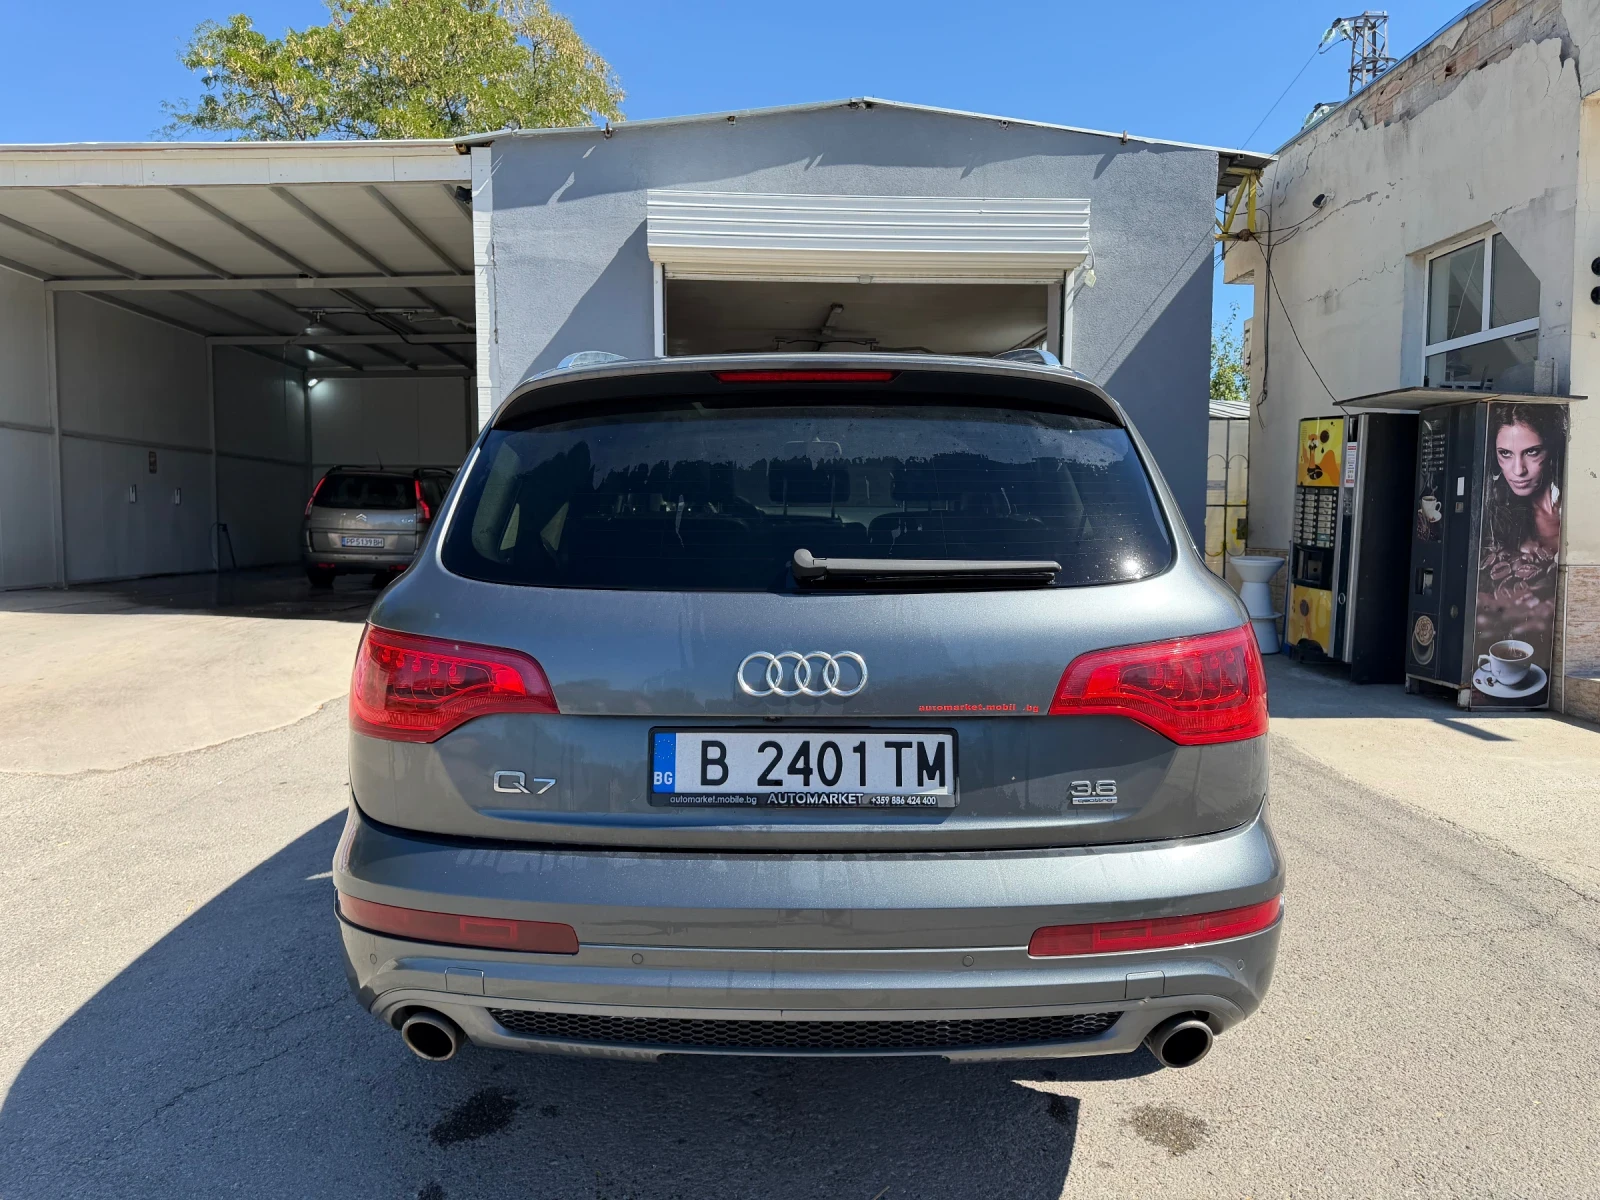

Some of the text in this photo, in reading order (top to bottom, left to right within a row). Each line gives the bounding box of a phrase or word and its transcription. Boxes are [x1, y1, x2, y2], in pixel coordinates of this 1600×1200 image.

[700, 741, 946, 787] B 2401 TM
[493, 770, 556, 795] Q7
[653, 771, 673, 785] BG
[1070, 780, 1117, 796] 3.6
[670, 795, 757, 805] automarket.mobile.bg
[767, 793, 864, 804] AUTOMARKET
[871, 796, 889, 804] +359
[906, 796, 921, 804] 424
[922, 796, 936, 804] 400
